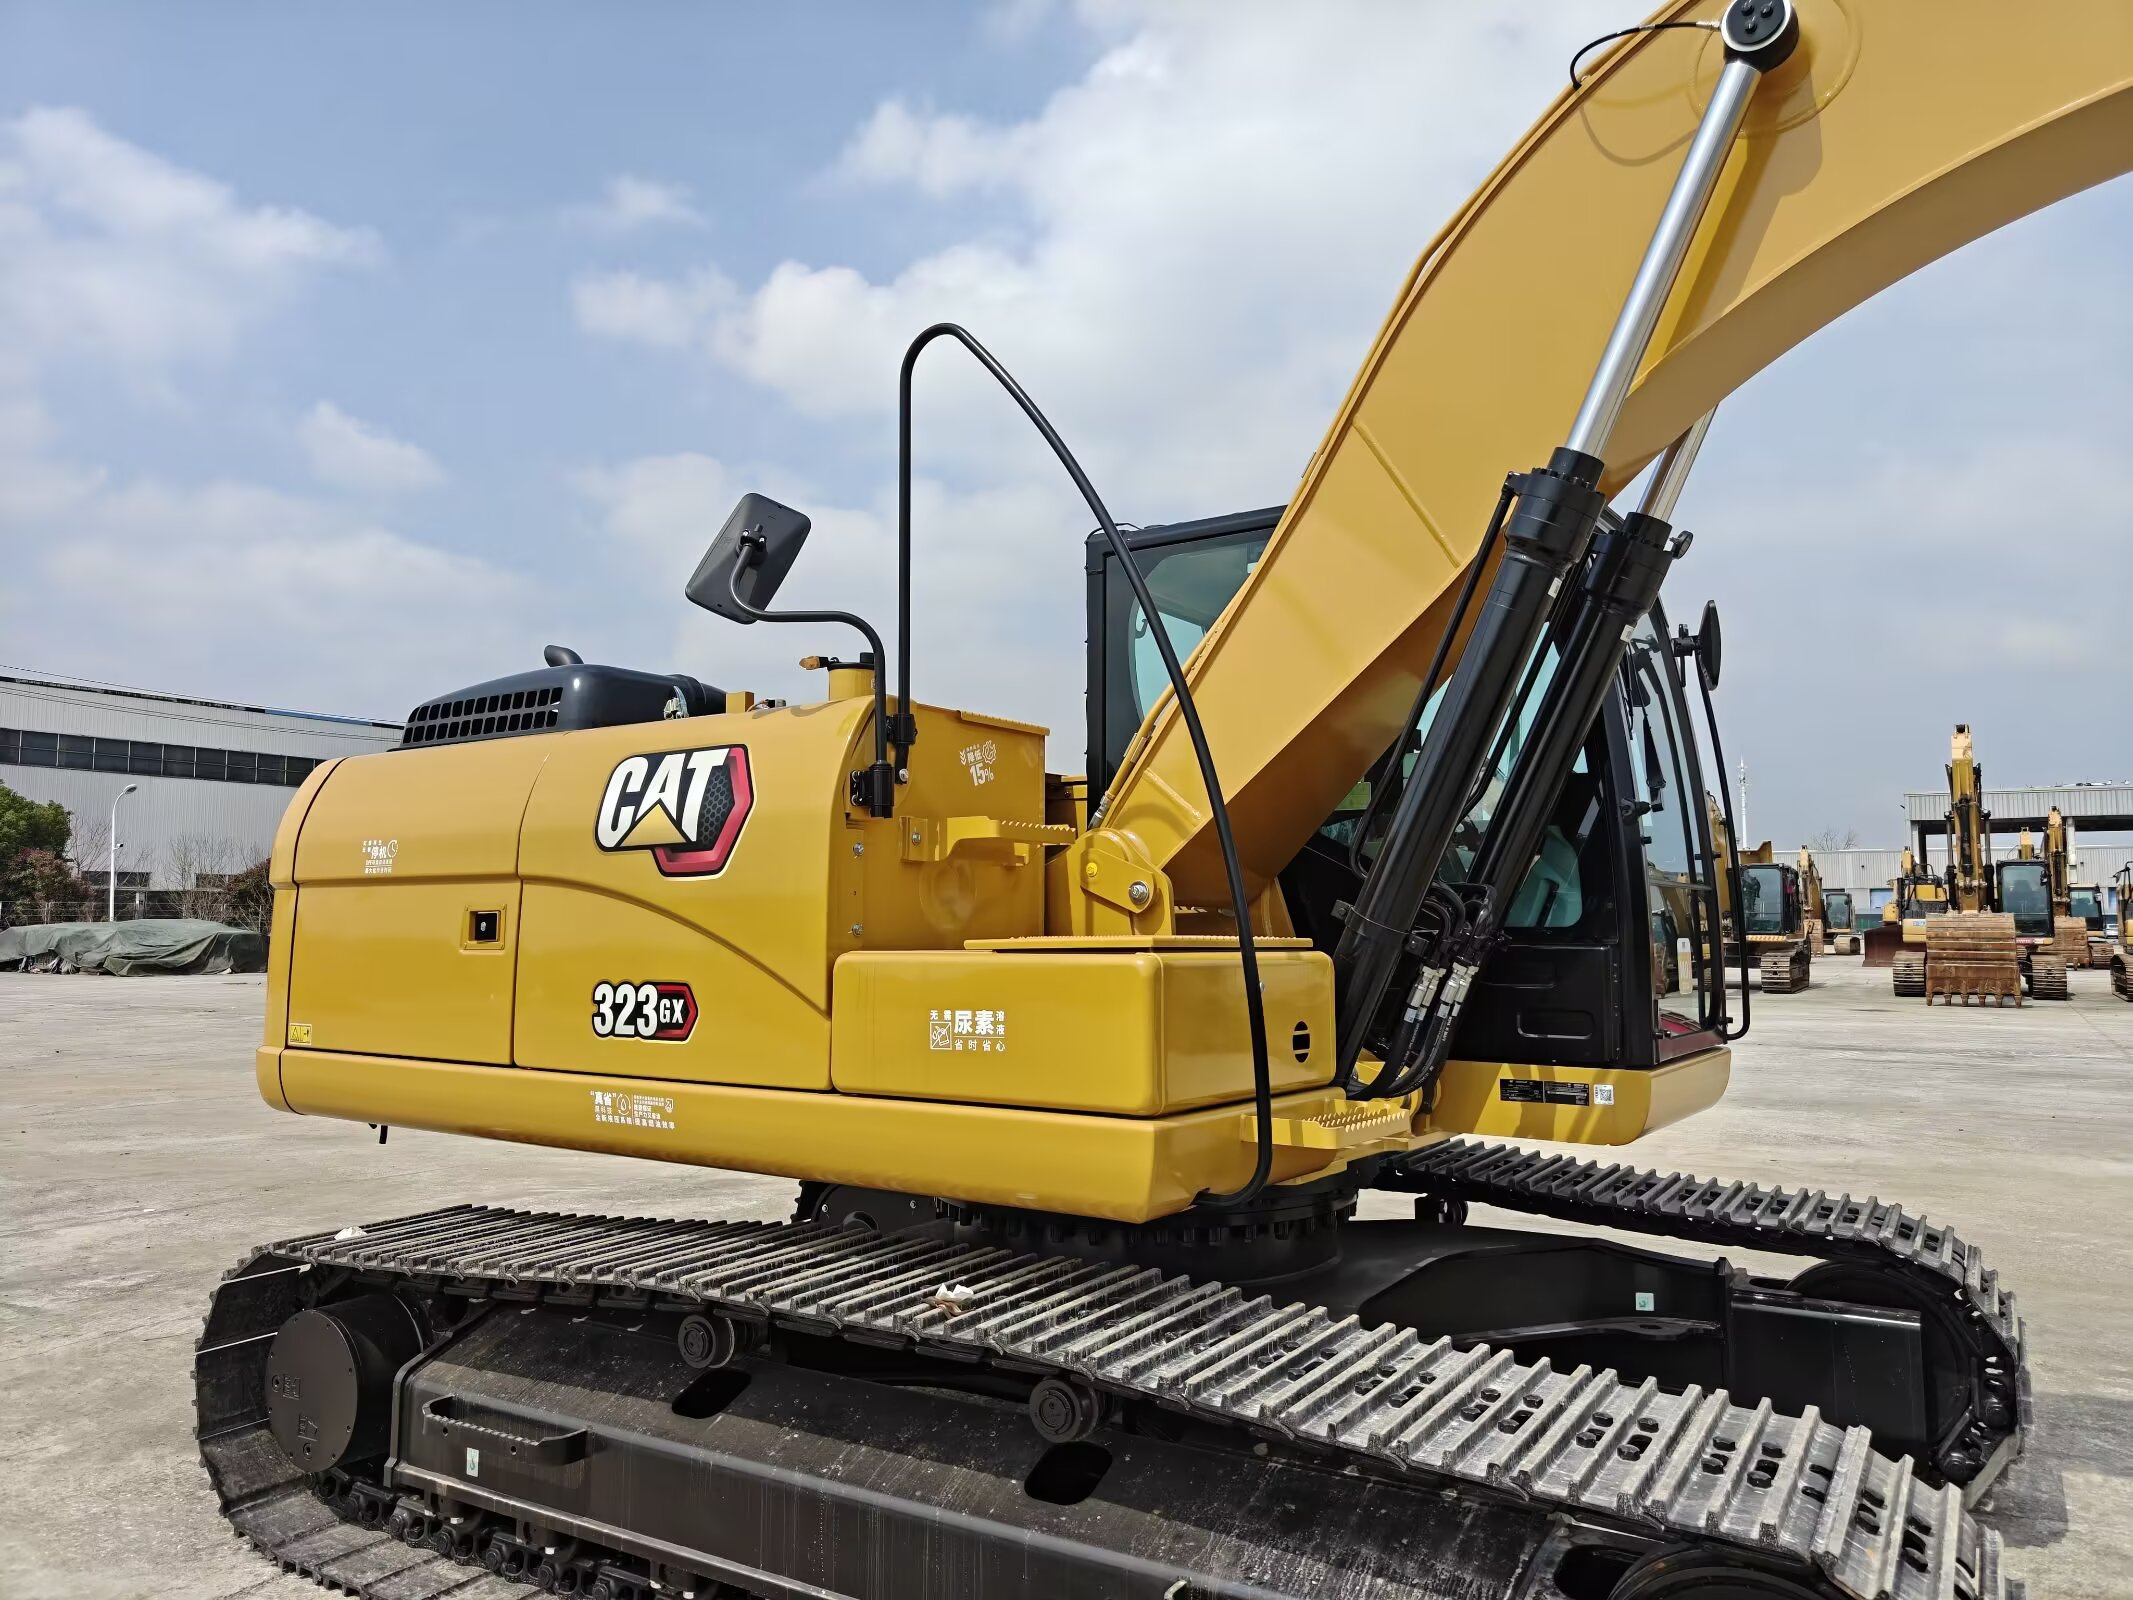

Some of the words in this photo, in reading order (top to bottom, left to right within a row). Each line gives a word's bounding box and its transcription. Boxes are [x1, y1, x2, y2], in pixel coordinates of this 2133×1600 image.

[970, 763, 995, 786] 15%
[598, 748, 730, 848] CAT
[593, 983, 658, 1037] 323
[659, 998, 685, 1024] GX
[954, 1010, 995, 1035] 尿素
[954, 1039, 1006, 1052] 省时省心
